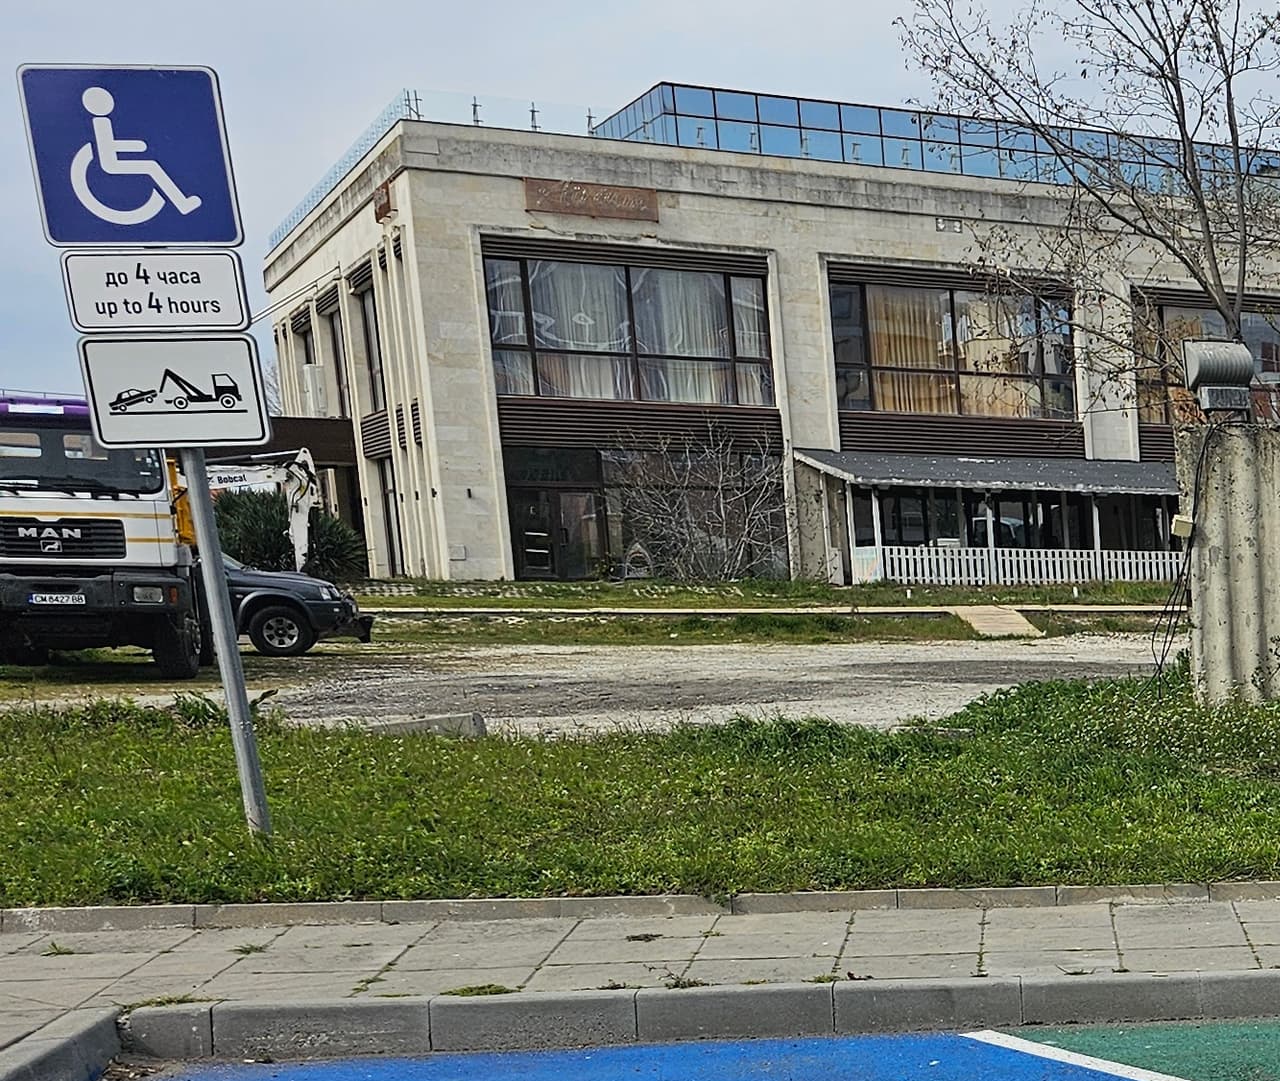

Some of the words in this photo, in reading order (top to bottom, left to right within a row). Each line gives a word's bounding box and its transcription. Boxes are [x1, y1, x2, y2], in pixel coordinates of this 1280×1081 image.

[105, 271, 128, 288] до
[135, 263, 150, 285] 4
[157, 271, 201, 285] часа
[95, 301, 118, 318] up
[123, 298, 142, 314] to
[148, 291, 163, 314] 4
[167, 297, 221, 314] hours
[18, 527, 81, 538] MAN
